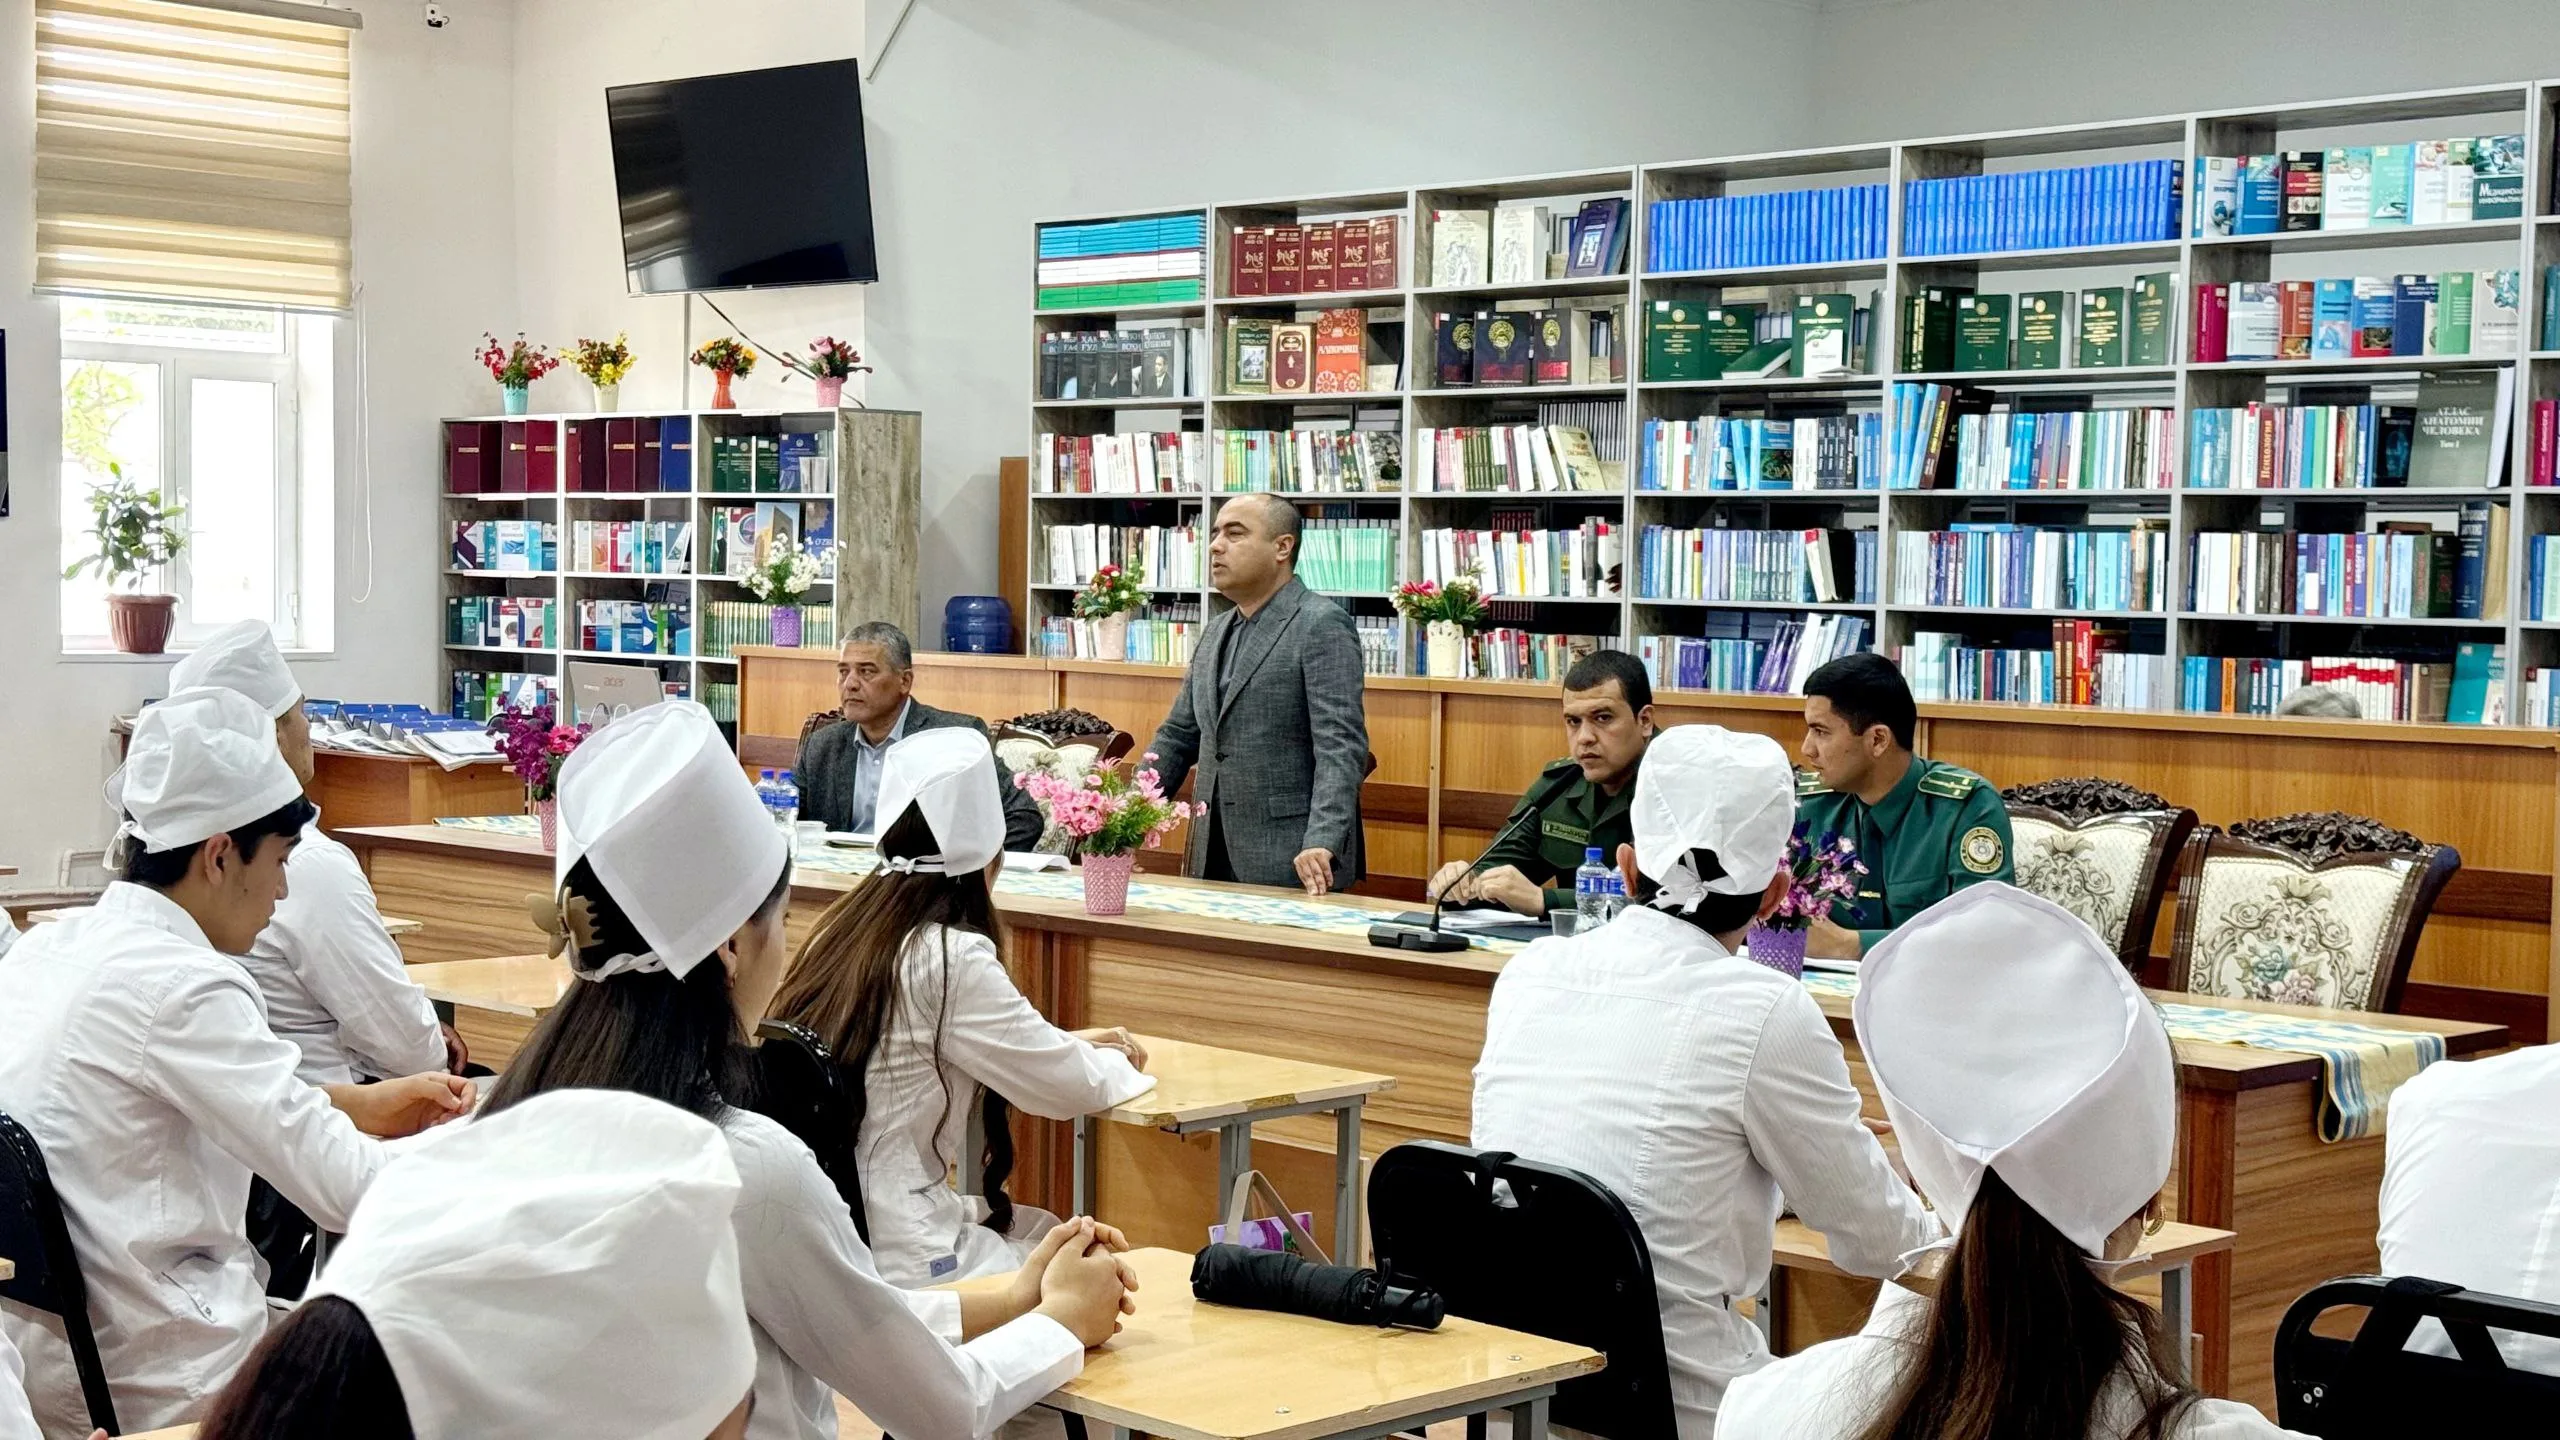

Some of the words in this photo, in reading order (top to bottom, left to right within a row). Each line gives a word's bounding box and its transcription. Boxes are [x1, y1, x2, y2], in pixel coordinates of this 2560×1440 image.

[2436, 407, 2472, 417] АТЛАС
[2422, 417, 2484, 427] АНАТОМИИ
[2421, 426, 2481, 436] ЧЕЛОВЕКА
[2260, 420, 2273, 480] Психология
[603, 676, 625, 687] acer
